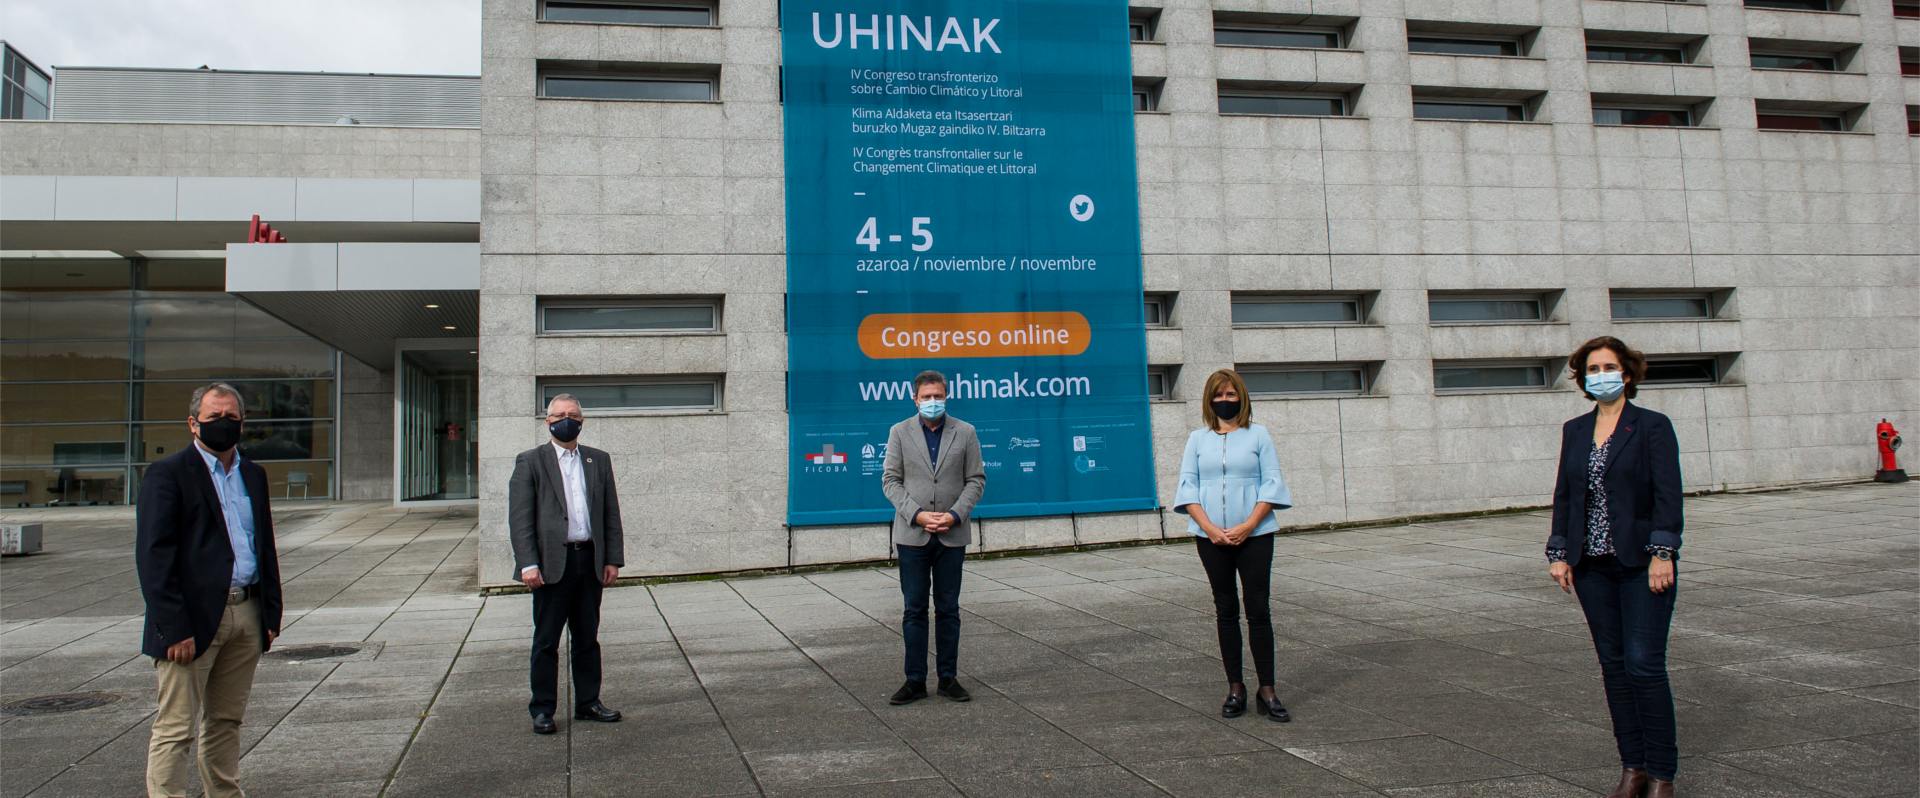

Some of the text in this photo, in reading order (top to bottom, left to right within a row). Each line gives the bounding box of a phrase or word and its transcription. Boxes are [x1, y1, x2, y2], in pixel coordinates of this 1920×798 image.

[812, 12, 1002, 54] UHINAK
[850, 69, 999, 84] IV Congreso transfronterizo
[850, 83, 1023, 99] sobre Cambio Climático y Litoral
[852, 108, 1013, 122] Klima Aldaketa eta Itsasertzari
[852, 122, 1046, 138] buruzko Mugaz gaindiko IV. Biltzarra
[853, 147, 1023, 162] IV Congrès transfrontalier sur le
[853, 161, 1037, 177] Changement Climatique et Littoral
[855, 217, 881, 252] 4
[911, 217, 934, 252] 5
[856, 259, 910, 272] azaroa
[923, 256, 1007, 271] noviembre
[1020, 256, 1097, 271] novembre
[881, 324, 1070, 353] Congreso online
[859, 372, 1091, 402] wwhinak.com
[805, 465, 848, 474] FICOBA
